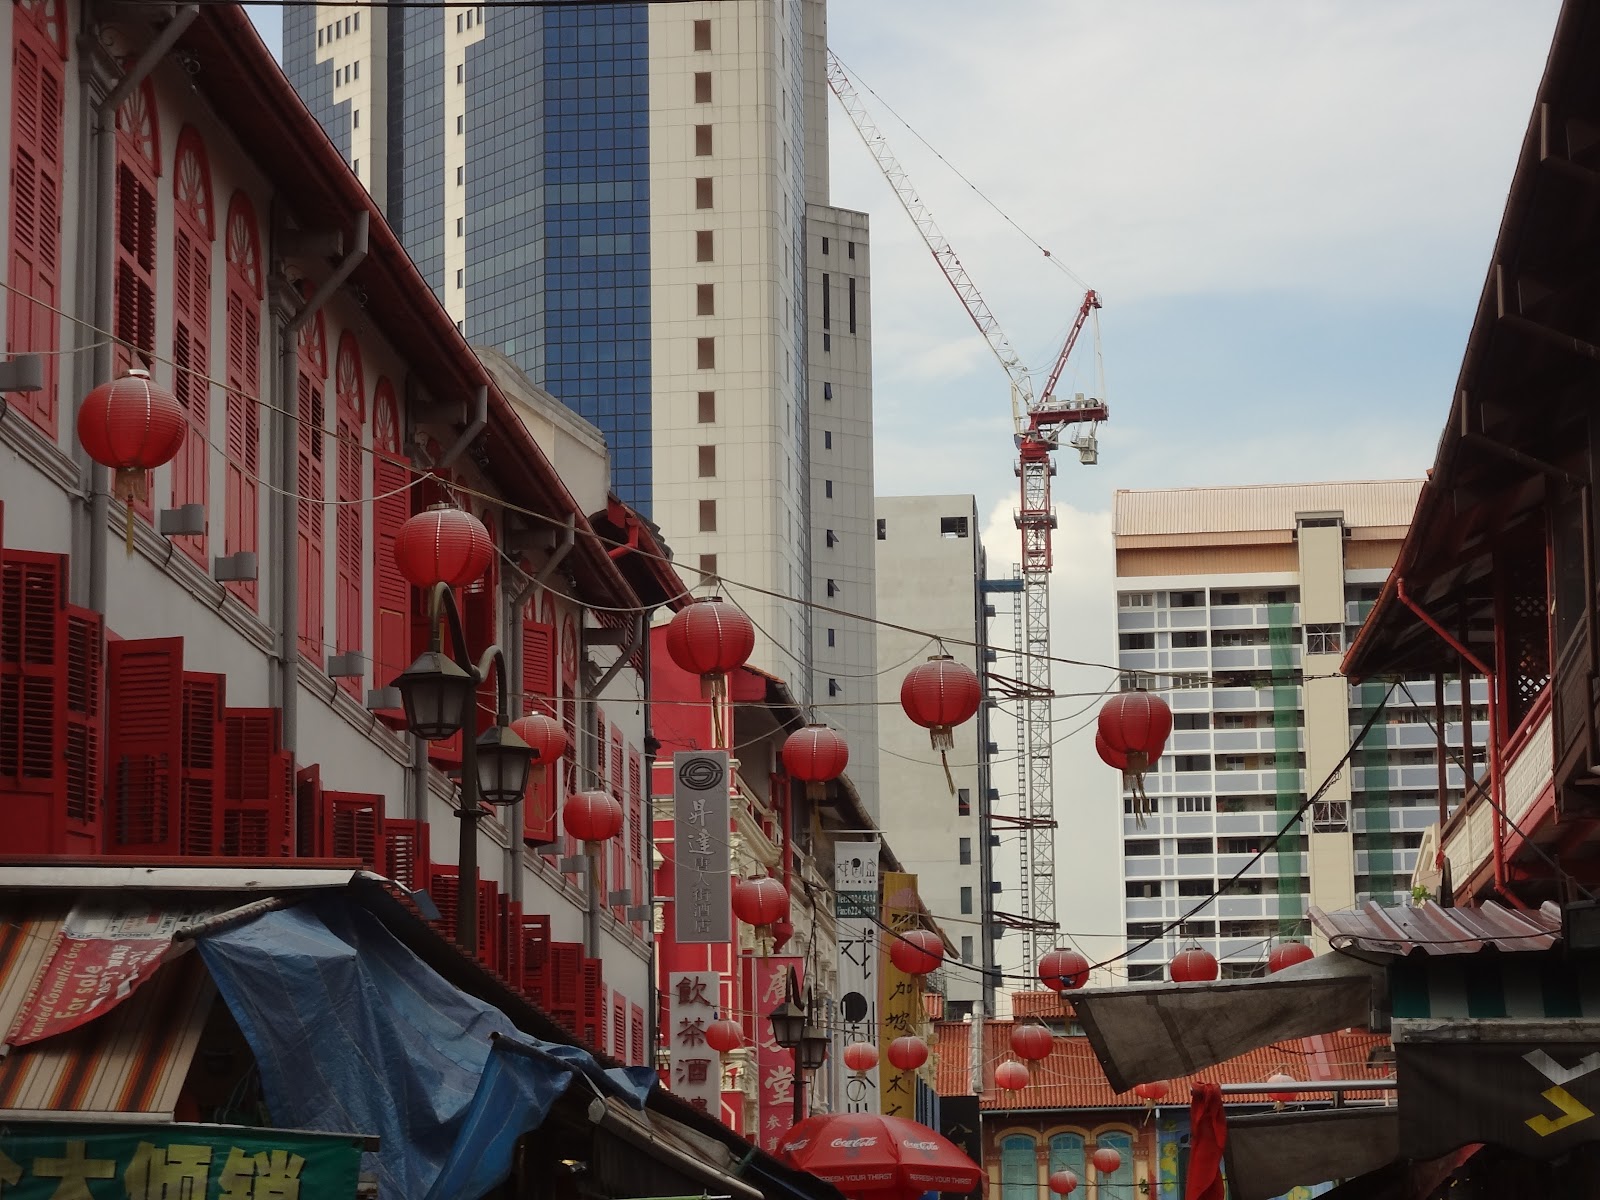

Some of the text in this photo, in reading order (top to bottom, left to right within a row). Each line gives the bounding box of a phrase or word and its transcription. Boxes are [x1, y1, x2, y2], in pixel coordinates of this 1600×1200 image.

[22, 1005, 53, 1040] randed
[44, 960, 75, 1005] Cosmetics
[63, 942, 88, 958] bag
[54, 965, 103, 1018] For sale
[820, 1172, 893, 1183] FRESH YOUR THIRST
[909, 1173, 972, 1185] REFRESH YOUR THIRST
